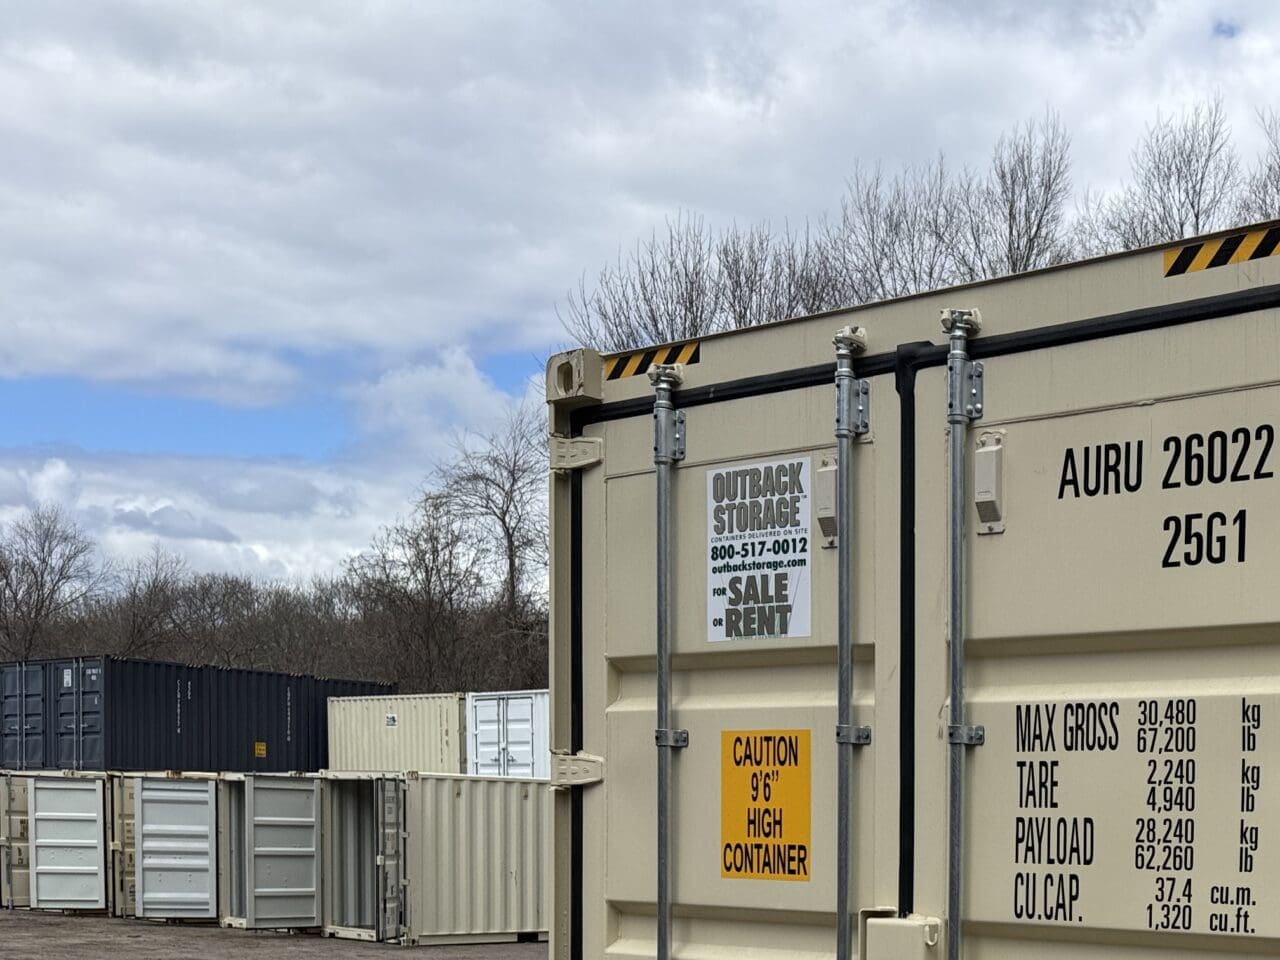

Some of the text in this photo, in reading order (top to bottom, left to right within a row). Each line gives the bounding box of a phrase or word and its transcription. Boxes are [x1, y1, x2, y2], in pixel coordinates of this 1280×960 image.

[712, 462, 804, 503] OUTBACK
[1057, 440, 1143, 499] AURU
[713, 495, 801, 535] STORAGE
[710, 533, 746, 543] CONTAINERS
[748, 530, 780, 539] DELIVERED
[710, 537, 808, 561] 800-517-0012
[1161, 509, 1247, 568] 25G1
[711, 558, 807, 574] outbackstorage.com
[712, 572, 789, 607] FOR SALE
[712, 604, 792, 637] OR RENT
[1016, 697, 1261, 752] MAX GROSS 30,480 kg
[1137, 725, 1256, 754] 67,200 lb
[733, 736, 798, 767] CAUTION
[1016, 758, 1261, 808] TARE 2,240 kg
[1146, 786, 1255, 813] 4,940 lb
[747, 807, 783, 839] HIGH
[1014, 816, 1259, 866] PAYLOAD 28,240 kg
[723, 842, 808, 876] CONTAINER
[1135, 845, 1253, 873] 62,260 lb
[1013, 872, 1257, 922] CU.CAP. 37.4 cu.m.
[1146, 903, 1256, 934] 1,320 cu.ft.
